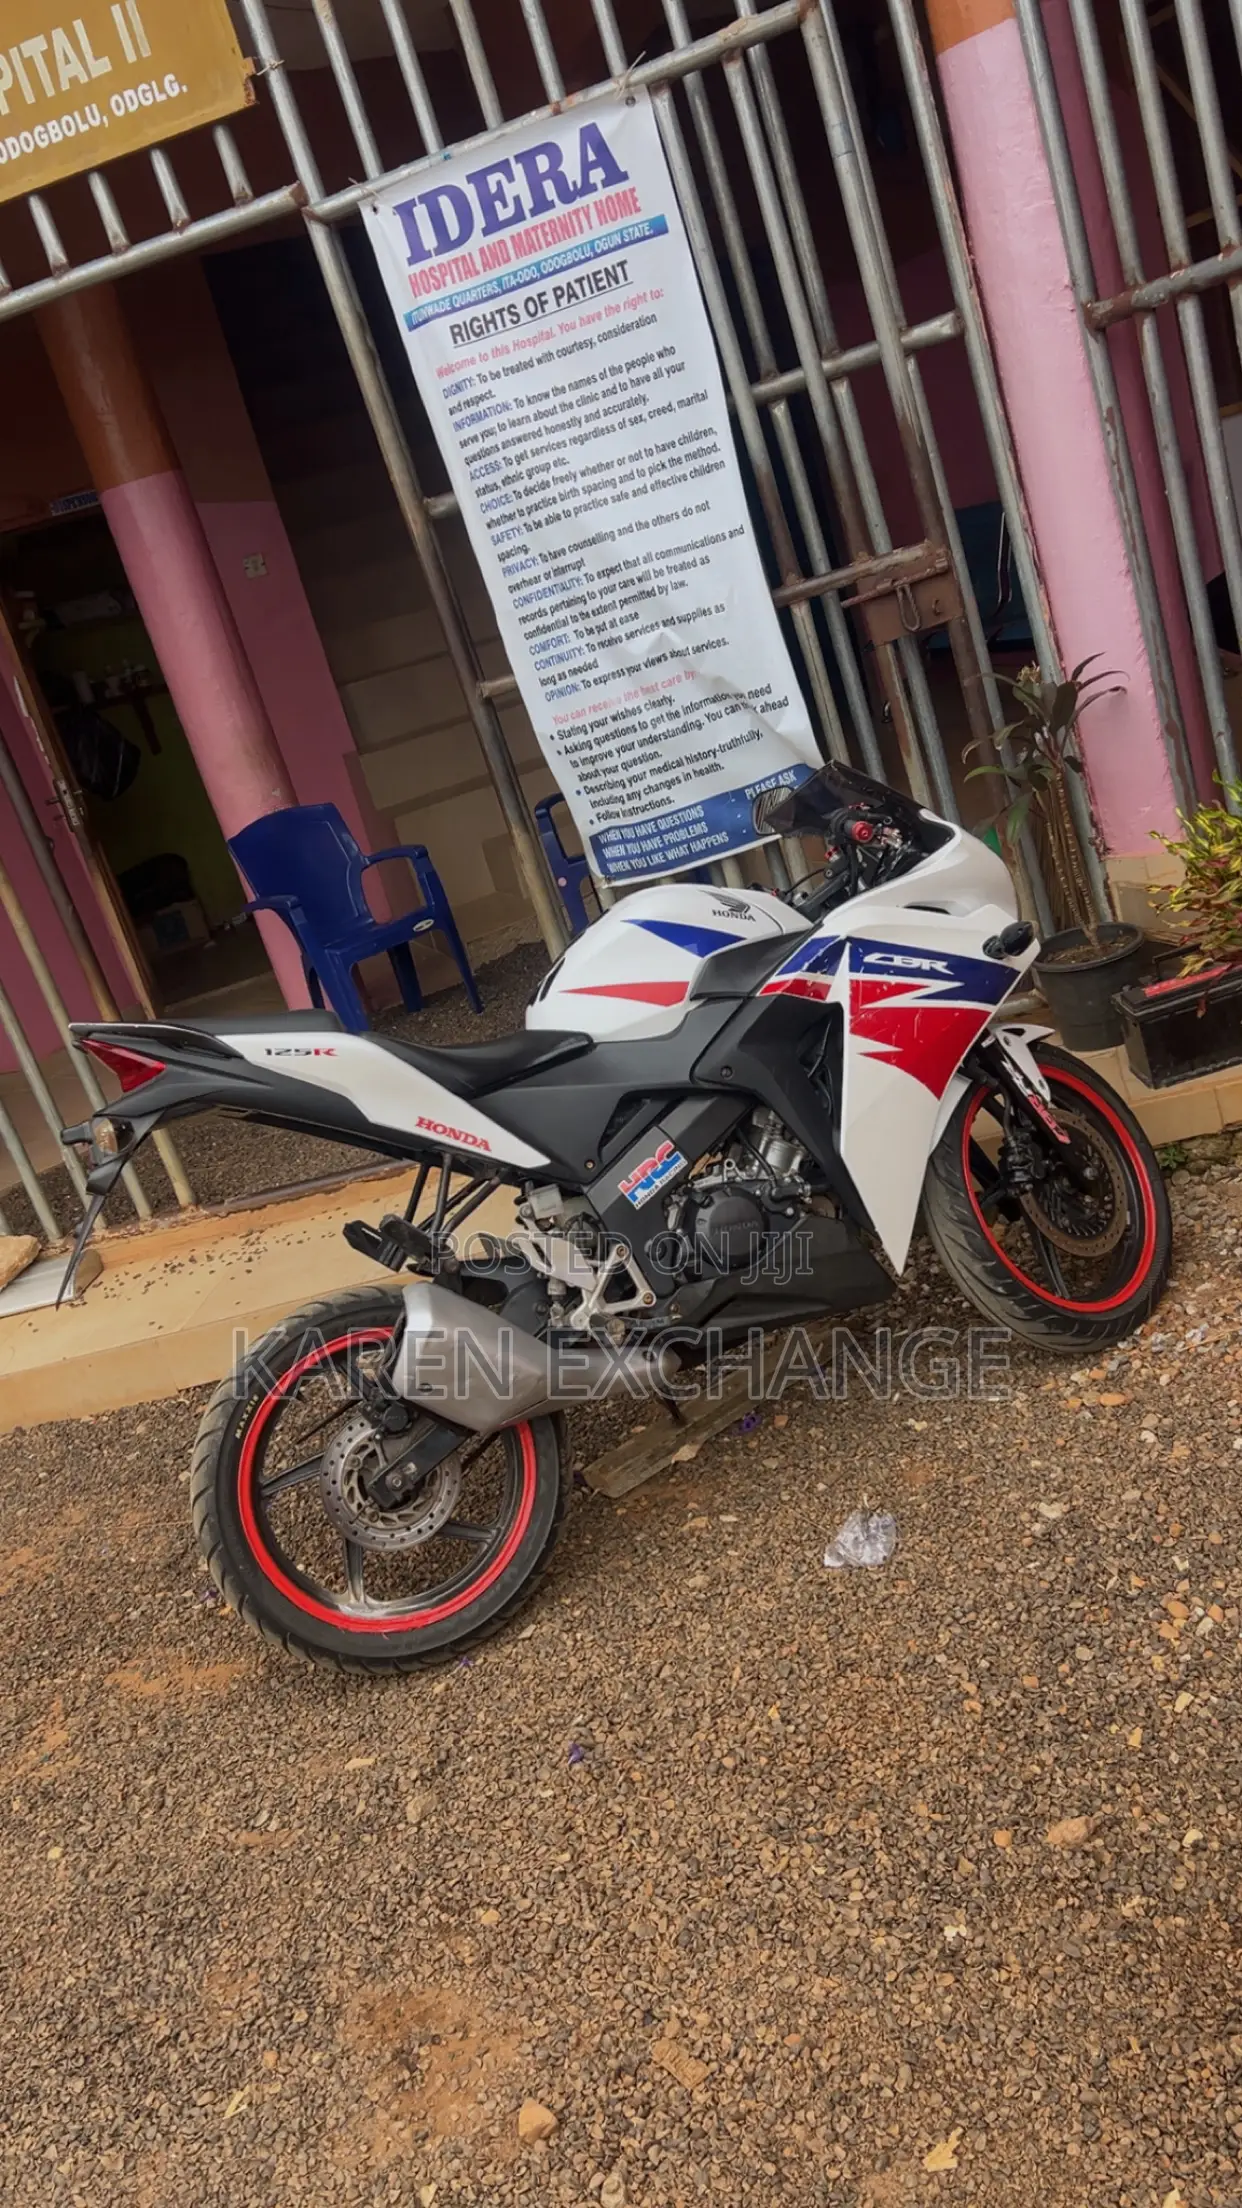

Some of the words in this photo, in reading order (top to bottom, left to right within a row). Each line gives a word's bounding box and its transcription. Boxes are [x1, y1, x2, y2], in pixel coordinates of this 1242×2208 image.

[109, 73, 188, 117] ODGLG.
[391, 121, 630, 266] IDERA
[407, 251, 480, 299] HOSPITAL
[477, 238, 512, 272] AND
[508, 203, 593, 260] MATERNITY
[592, 186, 642, 226] HOME
[451, 280, 501, 308] QUARTERS,
[501, 265, 540, 290] ITA-ODO,
[539, 243, 596, 274] ODOGBOLU,
[594, 231, 622, 253] OGUN
[622, 221, 653, 242] STATE.
[448, 302, 521, 346] RIGHTS
[523, 290, 548, 318] OF
[551, 258, 628, 308] PATIENT
[435, 356, 476, 380] Welcome
[490, 343, 511, 358] this
[578, 310, 602, 327] have
[622, 291, 648, 311] right
[441, 375, 476, 399] DIGNITY:
[501, 356, 535, 377] treated
[534, 349, 555, 365] with
[555, 336, 596, 358] courtesy,
[596, 313, 658, 343] consideration
[452, 401, 512, 432] INFORMATION:
[524, 390, 550, 406] know
[567, 373, 598, 392] names
[624, 352, 655, 374] people
[458, 433, 479, 449] serve
[506, 414, 531, 428] learn
[532, 404, 558, 422] about
[574, 391, 600, 408] clinic
[628, 373, 651, 388] have
[663, 361, 685, 378] your
[462, 388, 496, 409] respect.
[463, 443, 500, 467] questions
[500, 426, 543, 450] answered
[542, 415, 582, 435] honestly
[601, 392, 649, 417] accurately.
[468, 459, 502, 482] ACCESS:
[529, 439, 567, 458] services
[567, 423, 616, 446] regardless
[647, 400, 676, 419] creed,
[676, 388, 708, 409] marital
[474, 481, 501, 498] status,
[500, 470, 524, 487] ethnic
[524, 461, 551, 480] group
[479, 492, 514, 514] CHOICE:
[522, 478, 551, 497] decide
[551, 470, 577, 486] freely
[578, 459, 614, 478] whether
[653, 439, 676, 454] have
[677, 426, 717, 446] children,
[485, 510, 516, 530] whether
[524, 495, 558, 517] practice
[557, 486, 580, 502] birth
[580, 477, 617, 496] spacing
[647, 459, 667, 478] pick
[683, 441, 721, 462] method.
[490, 524, 524, 546] SAFETY:
[543, 511, 562, 526] able
[572, 496, 609, 518] practice
[609, 489, 630, 503] safe
[649, 472, 688, 492] effective
[688, 459, 725, 479] children
[501, 555, 539, 578] PRIVACY:
[546, 547, 566, 561] have
[567, 530, 616, 553] counselling
[651, 510, 680, 527] others
[512, 575, 583, 609] CONFIDENTIALITY:
[596, 562, 623, 579] expect
[622, 555, 641, 570] that
[654, 531, 727, 560] communications
[507, 574, 541, 594] overhear
[517, 606, 548, 625] records
[548, 593, 587, 617] pertaining
[597, 582, 617, 600] your
[617, 577, 636, 590] care
[635, 569, 652, 584] will
[665, 556, 698, 575] treated
[523, 615, 569, 640] confidential
[590, 599, 617, 617] extent
[618, 586, 656, 610] permitted
[528, 632, 570, 656] COMFORT:
[618, 610, 639, 625] ease
[533, 645, 585, 671] CONTINUITY:
[623, 620, 660, 640] services
[675, 606, 712, 624] supplies
[544, 682, 581, 702] OPINION:
[592, 667, 626, 686] express
[642, 652, 668, 668] views
[668, 645, 690, 659] about
[690, 637, 729, 654] services.
[567, 657, 599, 677] needed
[556, 723, 588, 740] Stating
[608, 704, 642, 722] wishes
[643, 694, 675, 711] clearly.
[563, 739, 593, 755] Asking
[592, 723, 638, 748] questions
[578, 749, 614, 766] improve
[636, 718, 705, 748] understanding.
[759, 695, 789, 714] ahead
[576, 767, 602, 782] about
[620, 750, 662, 772] question.
[582, 778, 627, 795] Describing
[625, 770, 647, 787] your
[648, 756, 684, 776] medical
[642, 775, 682, 796] changes
[691, 761, 724, 778] health.
[777, 770, 796, 785] ASK
[598, 828, 622, 843] WHEN
[619, 826, 635, 839] YOU
[634, 820, 657, 837] HAVE
[656, 804, 704, 830] QUESTIONS
[602, 844, 626, 858] WHEN
[624, 841, 641, 854] YOU
[639, 835, 663, 852] HAVE
[661, 821, 708, 845] PROBLEMS
[606, 859, 631, 873] WHEN
[630, 856, 647, 869] YOU
[646, 851, 666, 866] LIKE
[663, 843, 689, 860] WHAT
[689, 830, 729, 852] HAPPENS
[711, 908, 757, 923] HONDA
[863, 952, 955, 976] CBR
[264, 1047, 338, 1058] 125R
[414, 1115, 492, 1152] HONDA
[617, 1139, 683, 1203] HRC
